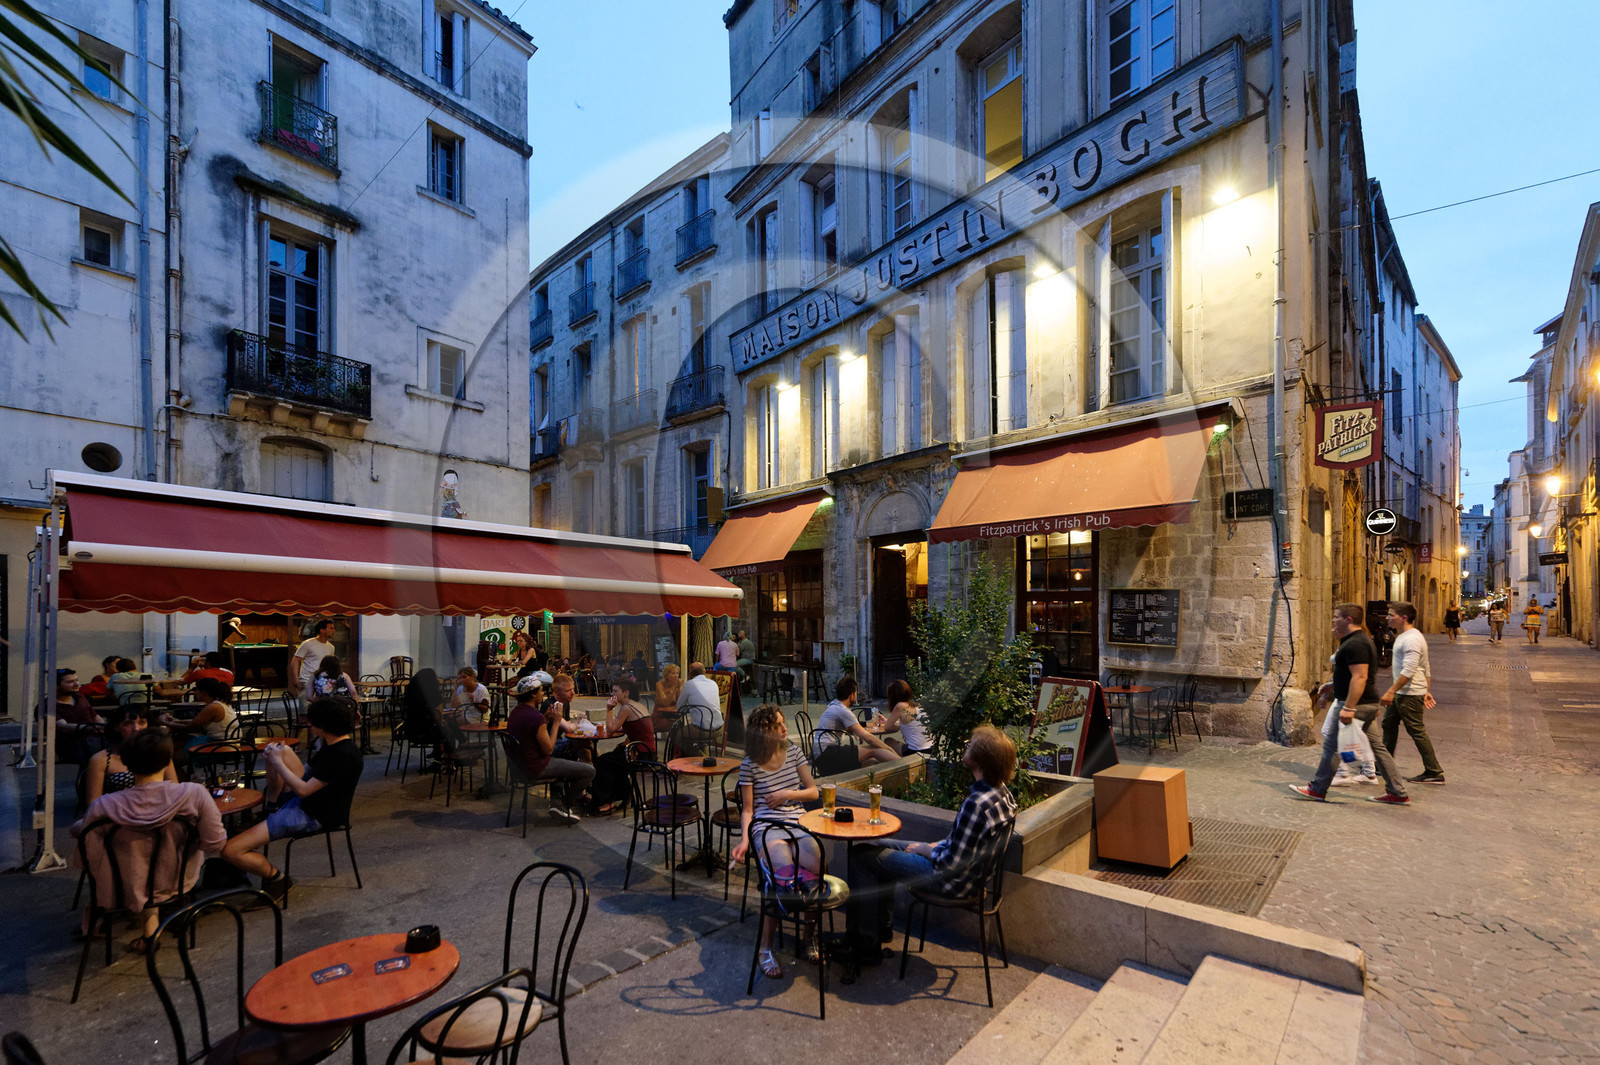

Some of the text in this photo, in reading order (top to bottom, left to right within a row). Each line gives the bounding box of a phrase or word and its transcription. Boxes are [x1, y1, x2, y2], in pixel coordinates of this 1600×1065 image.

[740, 75, 1213, 365] MAISON JUSTIN BOCH
[1317, 415, 1377, 456] PATRICK'S
[1339, 441, 1367, 456] IRISH PUB
[1240, 493, 1259, 501] PLACE
[1229, 504, 1248, 514] SINT
[1054, 517, 1081, 529] Irish
[1085, 514, 1111, 526] Pub
[747, 565, 757, 573] Pub
